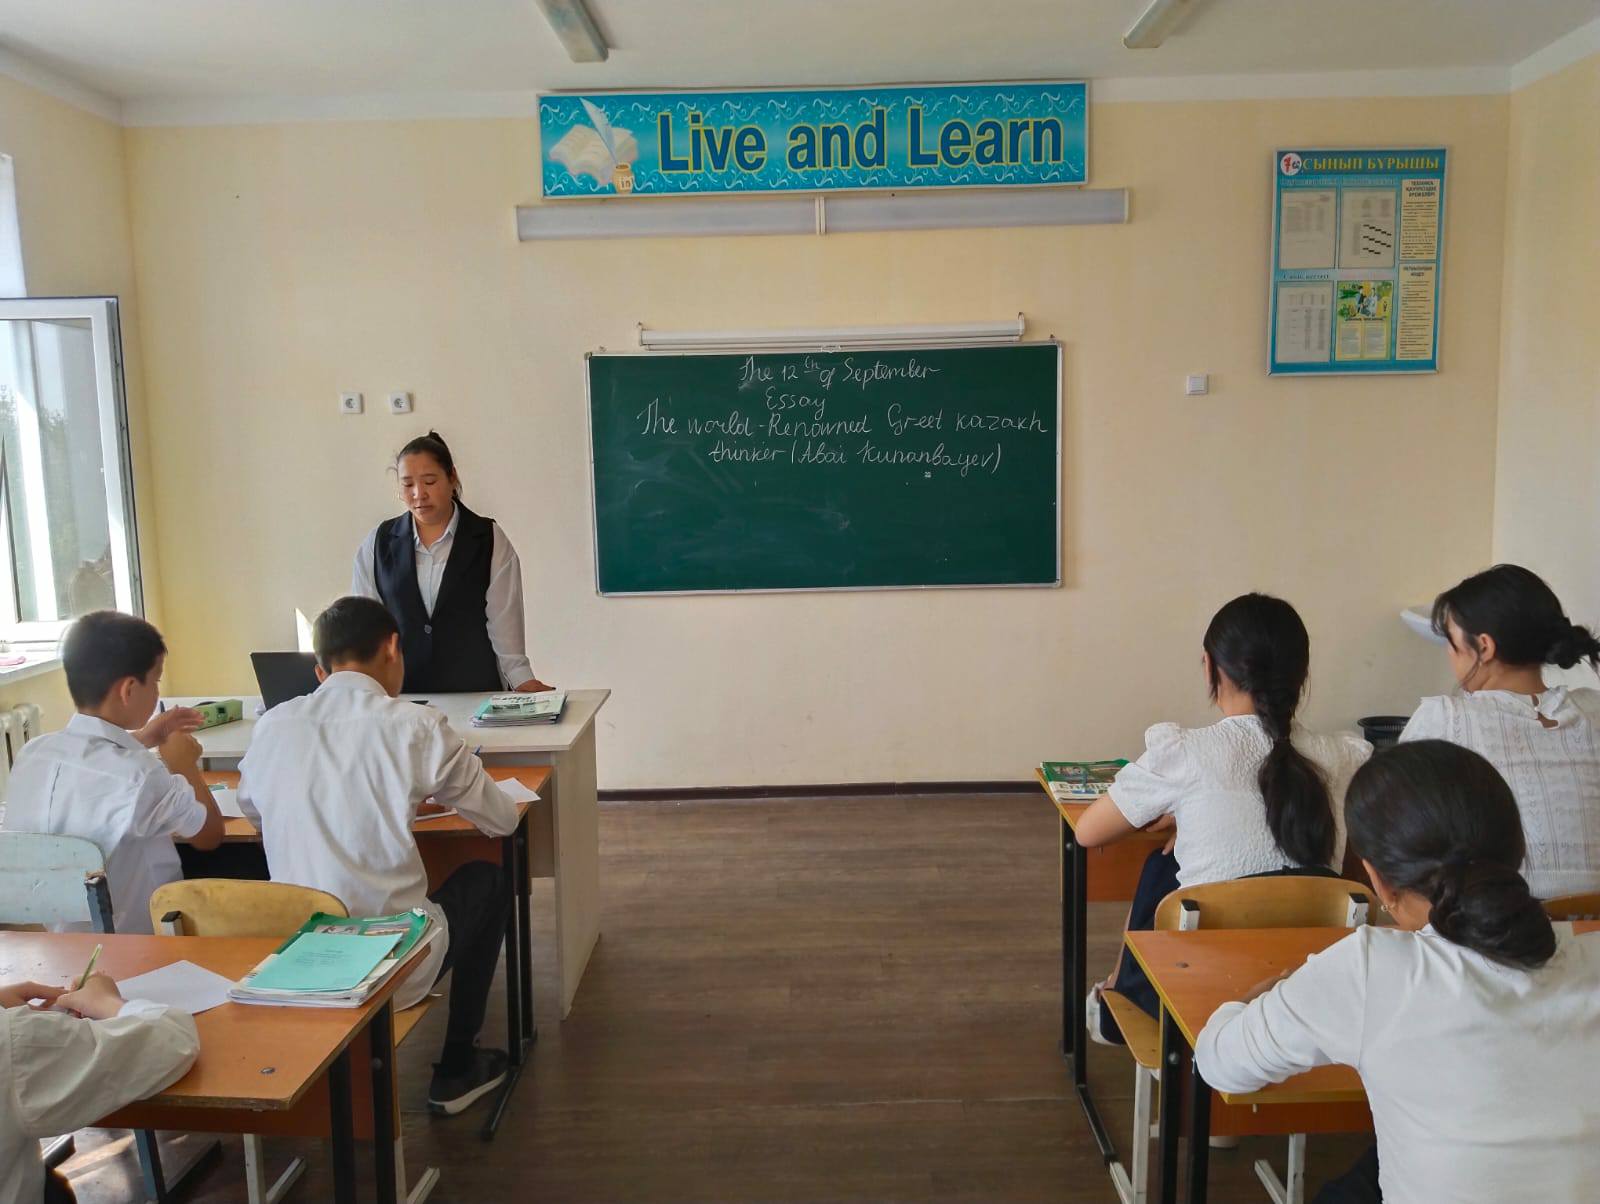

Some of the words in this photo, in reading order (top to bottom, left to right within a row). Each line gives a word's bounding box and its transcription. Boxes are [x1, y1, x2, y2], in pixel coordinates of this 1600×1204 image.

[658, 111, 767, 173] Live
[787, 106, 886, 170] and
[907, 106, 1063, 168] Learn
[739, 356, 774, 382] The
[842, 357, 942, 391] September
[636, 397, 679, 435] The
[765, 385, 826, 420] Essay
[708, 439, 786, 463] thinker
[791, 439, 848, 464] (Abai
